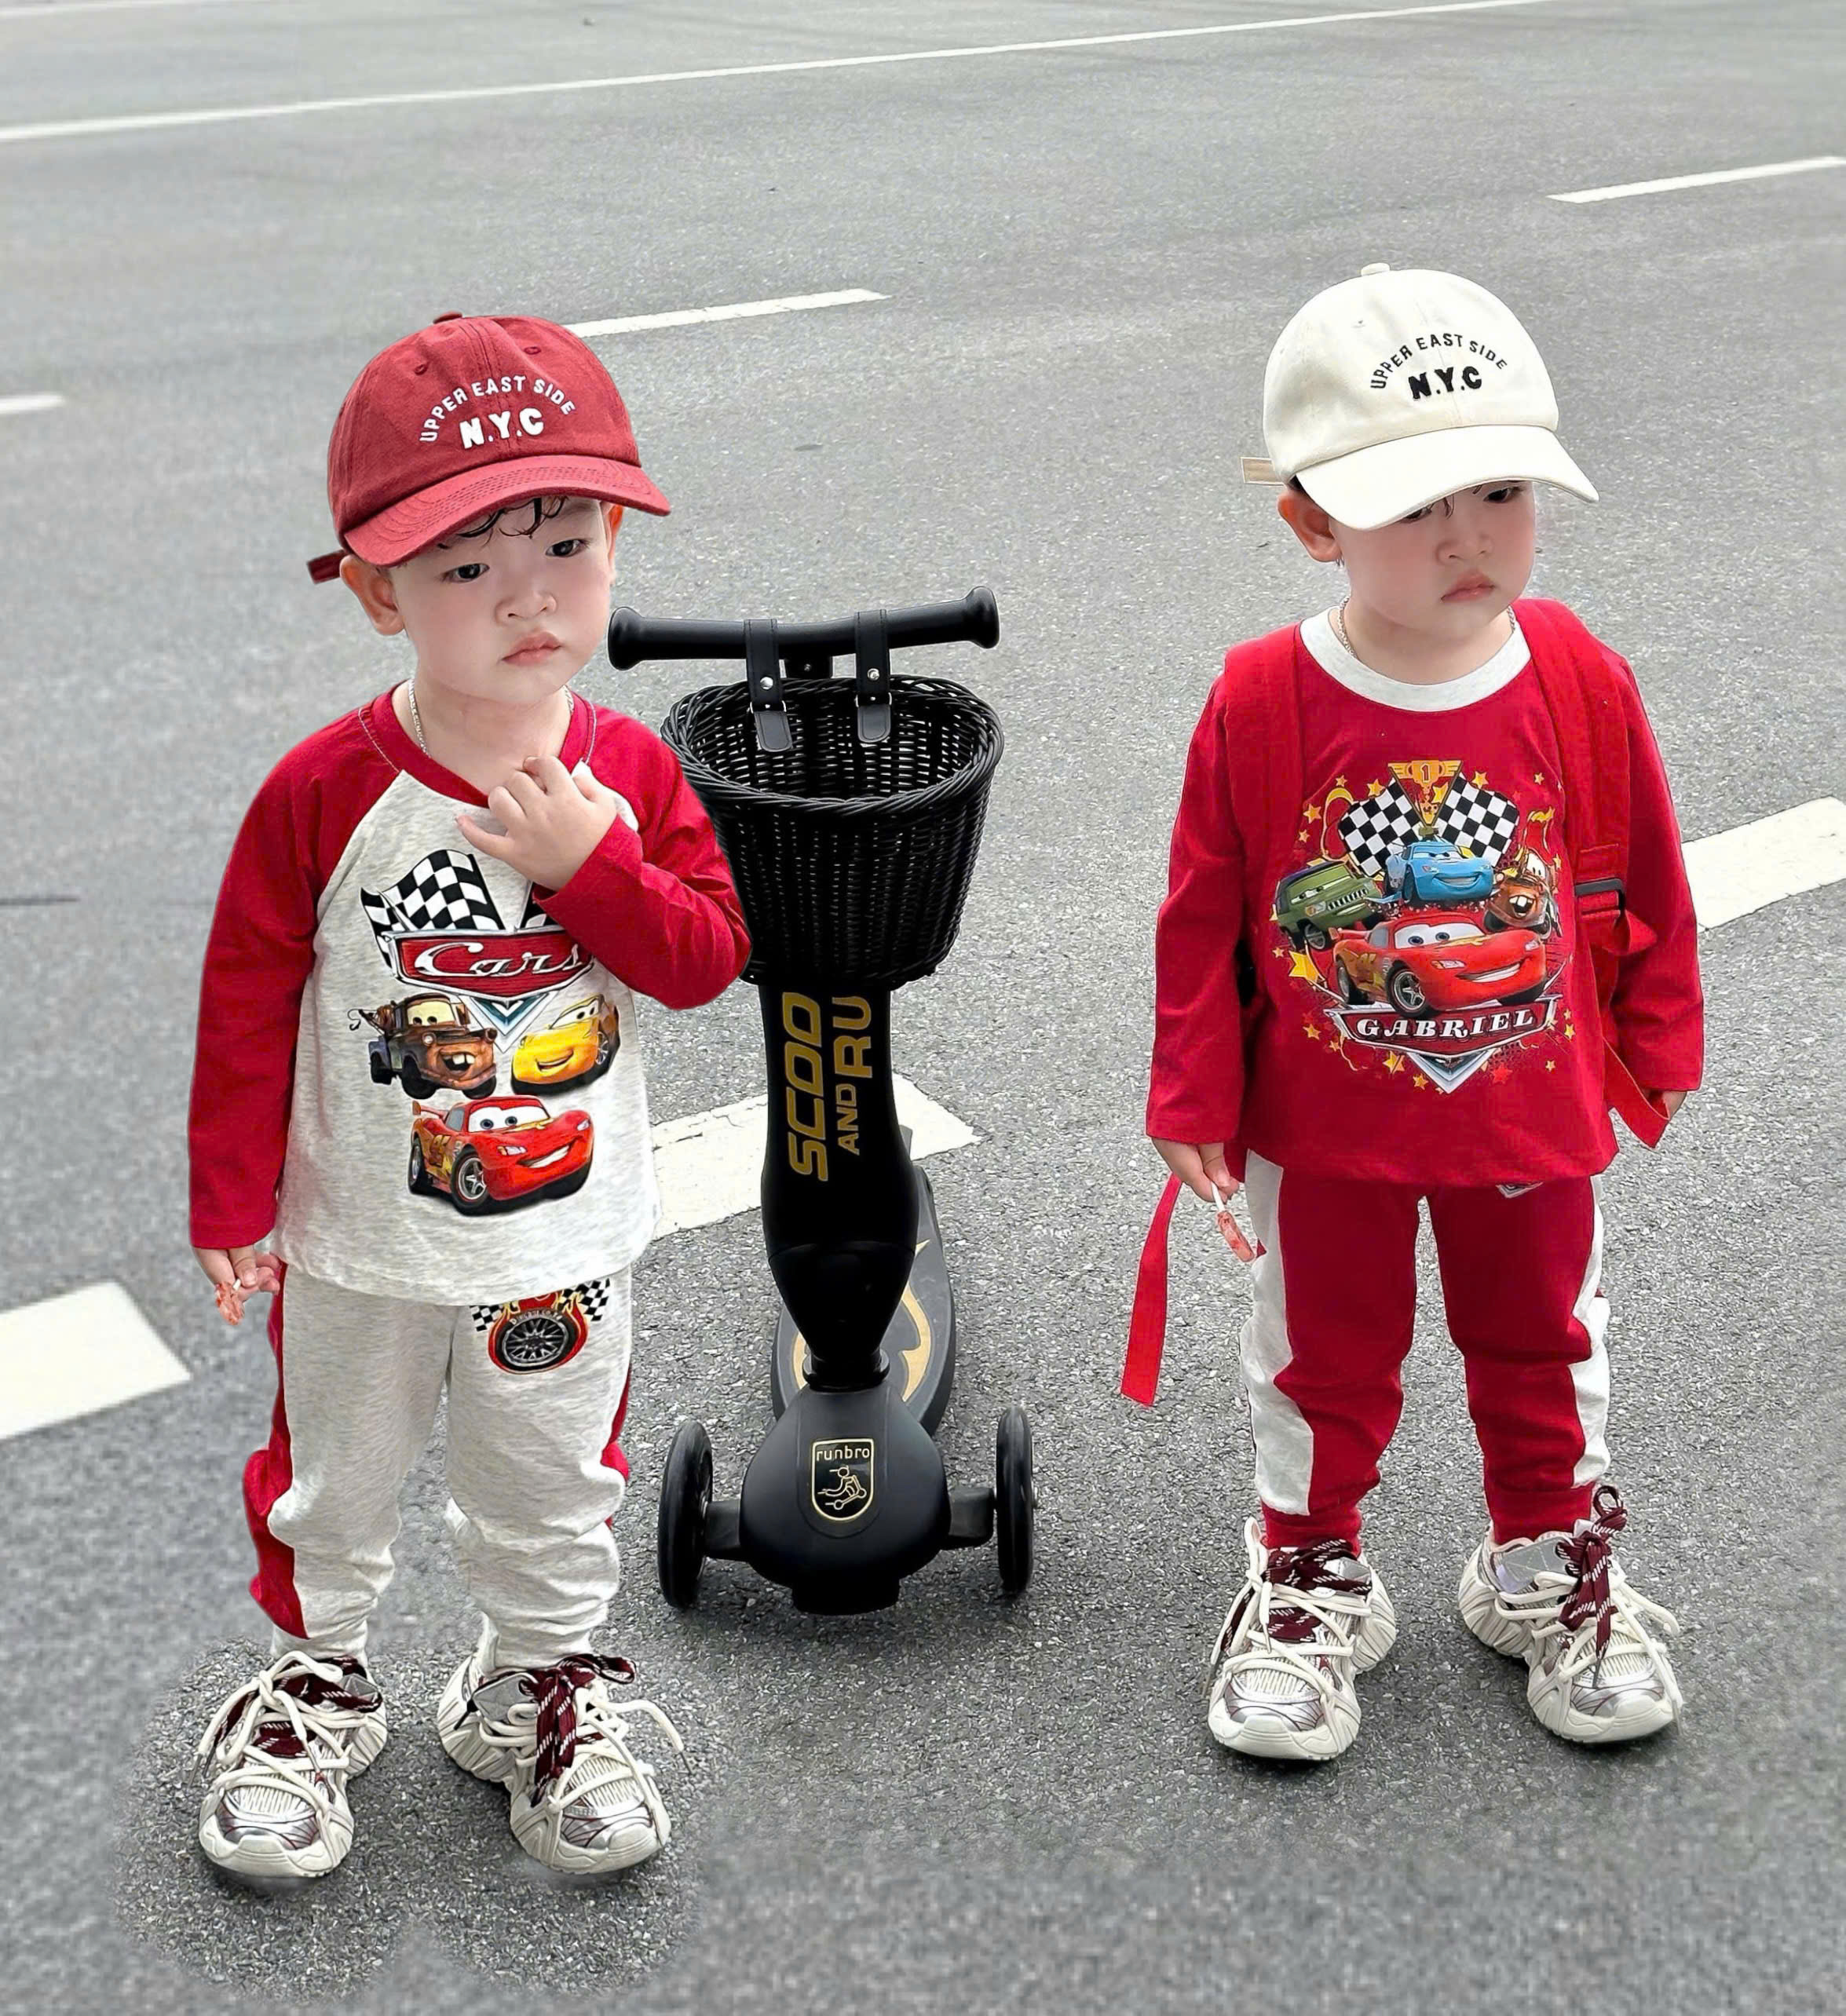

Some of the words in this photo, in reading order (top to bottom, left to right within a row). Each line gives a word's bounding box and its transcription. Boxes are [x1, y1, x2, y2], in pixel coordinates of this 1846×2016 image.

[1370, 345, 1413, 389] UPPER
[1416, 333, 1463, 351] EAST
[1469, 341, 1508, 370] SIDE
[1408, 366, 1482, 400] N.Y.C
[419, 388, 469, 442] UPPER
[471, 375, 527, 397] EAST
[533, 378, 576, 415] SIDE
[459, 407, 544, 449] N.Y.C
[1420, 763, 1431, 783] 1
[415, 942, 583, 977] Cars
[1357, 1009, 1533, 1038] GABRIEL
[835, 1083, 860, 1156] AND
[817, 1445, 870, 1462] runbro
